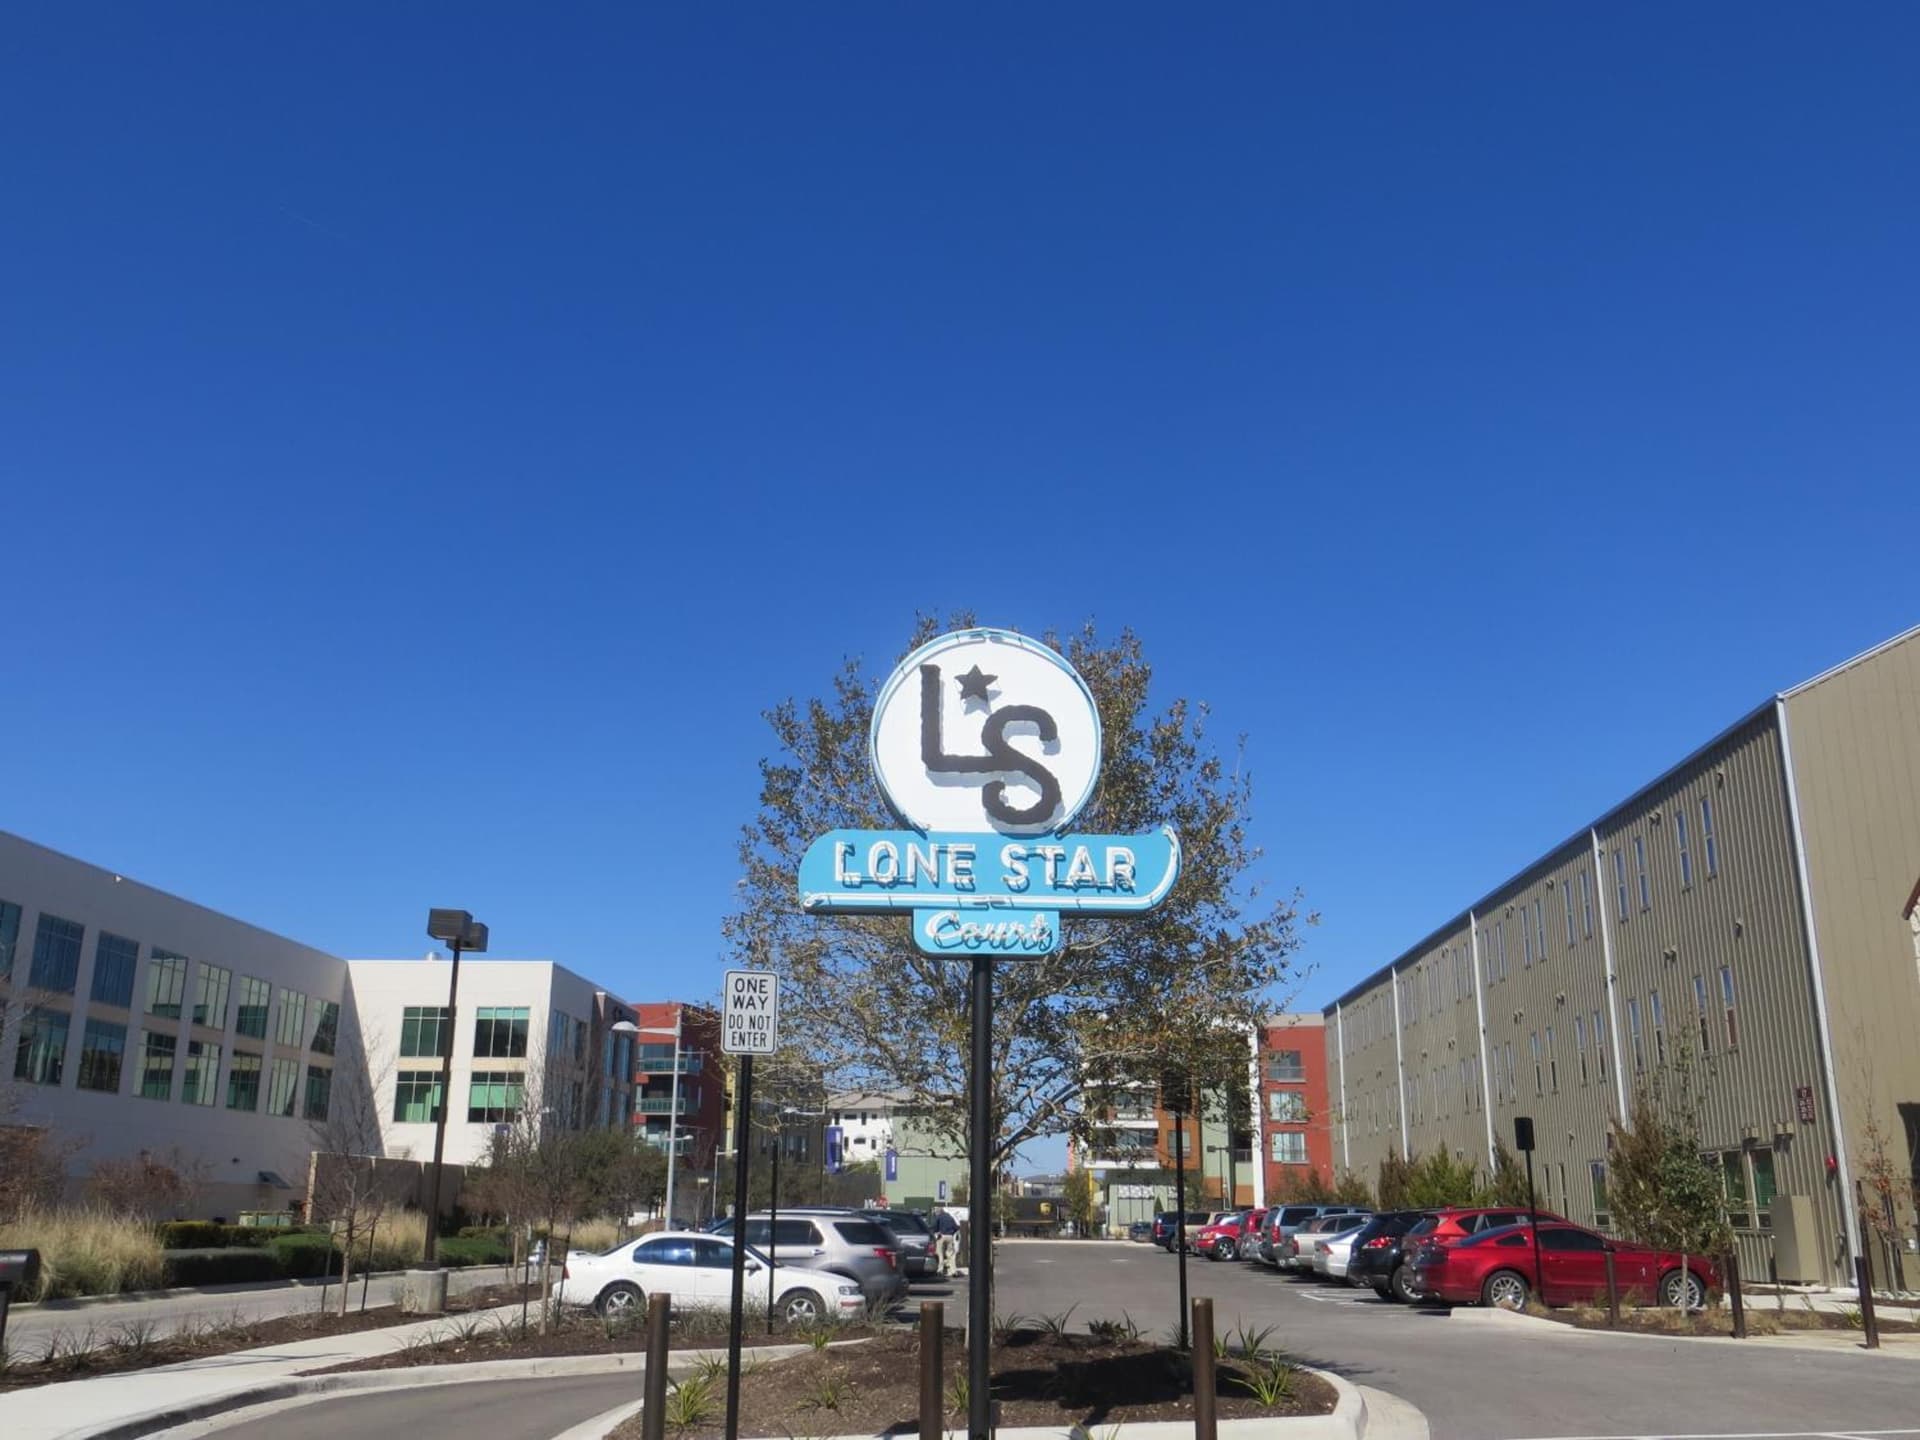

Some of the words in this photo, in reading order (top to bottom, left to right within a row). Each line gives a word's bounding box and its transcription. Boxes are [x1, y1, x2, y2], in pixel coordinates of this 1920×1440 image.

[834, 840, 976, 886] LONE
[1001, 843, 1137, 889] STAR
[924, 909, 1053, 949] Court
[734, 977, 769, 994] ONE
[733, 994, 769, 1010] WAY
[728, 1014, 744, 1029] DO
[749, 1014, 771, 1031] NOT
[731, 1031, 767, 1048] ENTER
